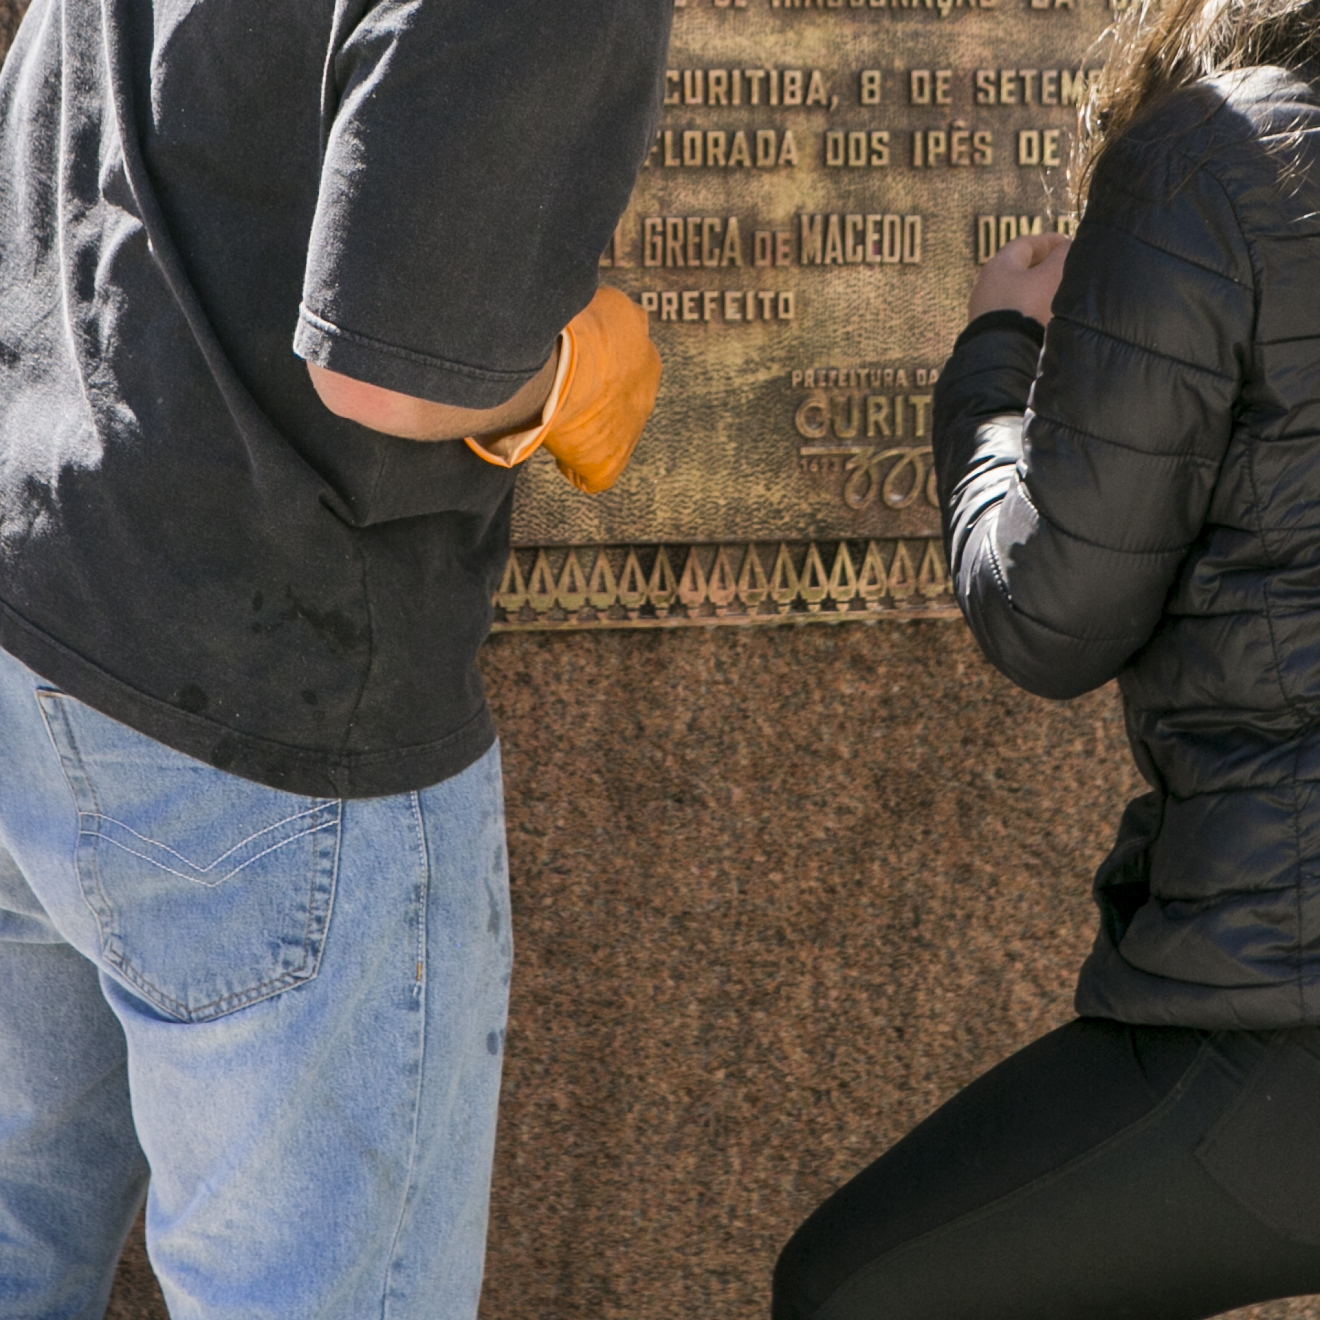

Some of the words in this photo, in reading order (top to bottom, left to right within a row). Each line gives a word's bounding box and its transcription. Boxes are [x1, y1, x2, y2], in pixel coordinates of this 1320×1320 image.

[664, 69, 838, 110] CURITIBA,
[861, 70, 881, 104] 8
[911, 70, 952, 105] DE
[826, 132, 890, 167] DOS
[913, 120, 993, 167] IPÊS
[1018, 130, 1060, 168] DE
[644, 216, 745, 268] GRECA
[753, 230, 791, 267] DE
[800, 213, 922, 265] MACEDO
[641, 290, 795, 321] PREFEITO
[791, 368, 909, 388] PREFEITURA
[795, 395, 931, 439] CURIT
